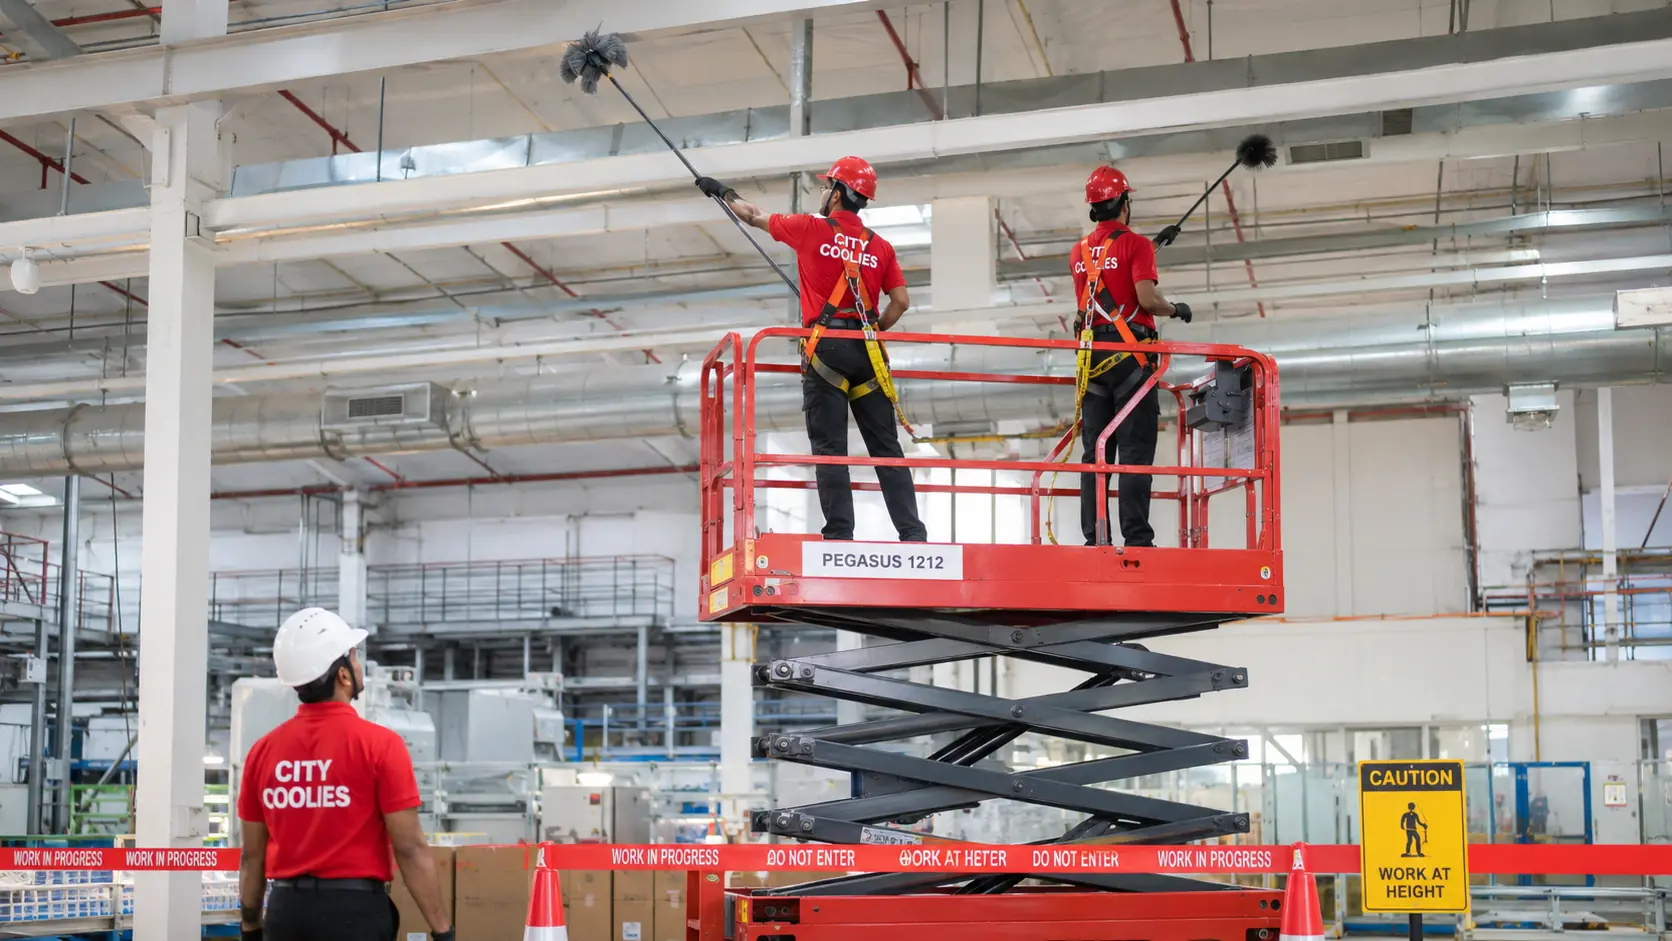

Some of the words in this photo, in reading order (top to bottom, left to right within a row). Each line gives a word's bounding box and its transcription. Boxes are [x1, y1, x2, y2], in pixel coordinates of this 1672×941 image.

[834, 232, 869, 251] CITY
[820, 243, 878, 269] COOLIES
[822, 552, 902, 568] PEGASUS
[908, 555, 944, 570] 1212
[275, 758, 333, 782] CITY
[1369, 769, 1453, 786] CAUTION
[262, 785, 351, 809] COOLIES
[13, 850, 41, 866] WORK
[42, 850, 51, 866] IN
[53, 850, 103, 867] PROGRESS
[125, 850, 154, 867] WORK
[155, 850, 165, 867] IN
[167, 850, 218, 867] PROGRESS
[611, 848, 645, 866] WORK
[647, 849, 657, 865] IN
[660, 848, 719, 866] PROGRESS
[788, 849, 812, 866] NOT
[816, 849, 856, 866] ENTER
[944, 850, 961, 867] AT
[965, 850, 1007, 867] HETER
[1033, 850, 1050, 867] DO
[1053, 850, 1078, 867] NOT
[1081, 850, 1119, 868] ENTER
[1157, 850, 1193, 867] WORK
[1195, 850, 1207, 867] IN
[1210, 850, 1272, 868] PROGRESS
[1378, 867, 1427, 880] WORK
[1431, 867, 1451, 880] AT
[1386, 885, 1445, 898] HEIGHT
